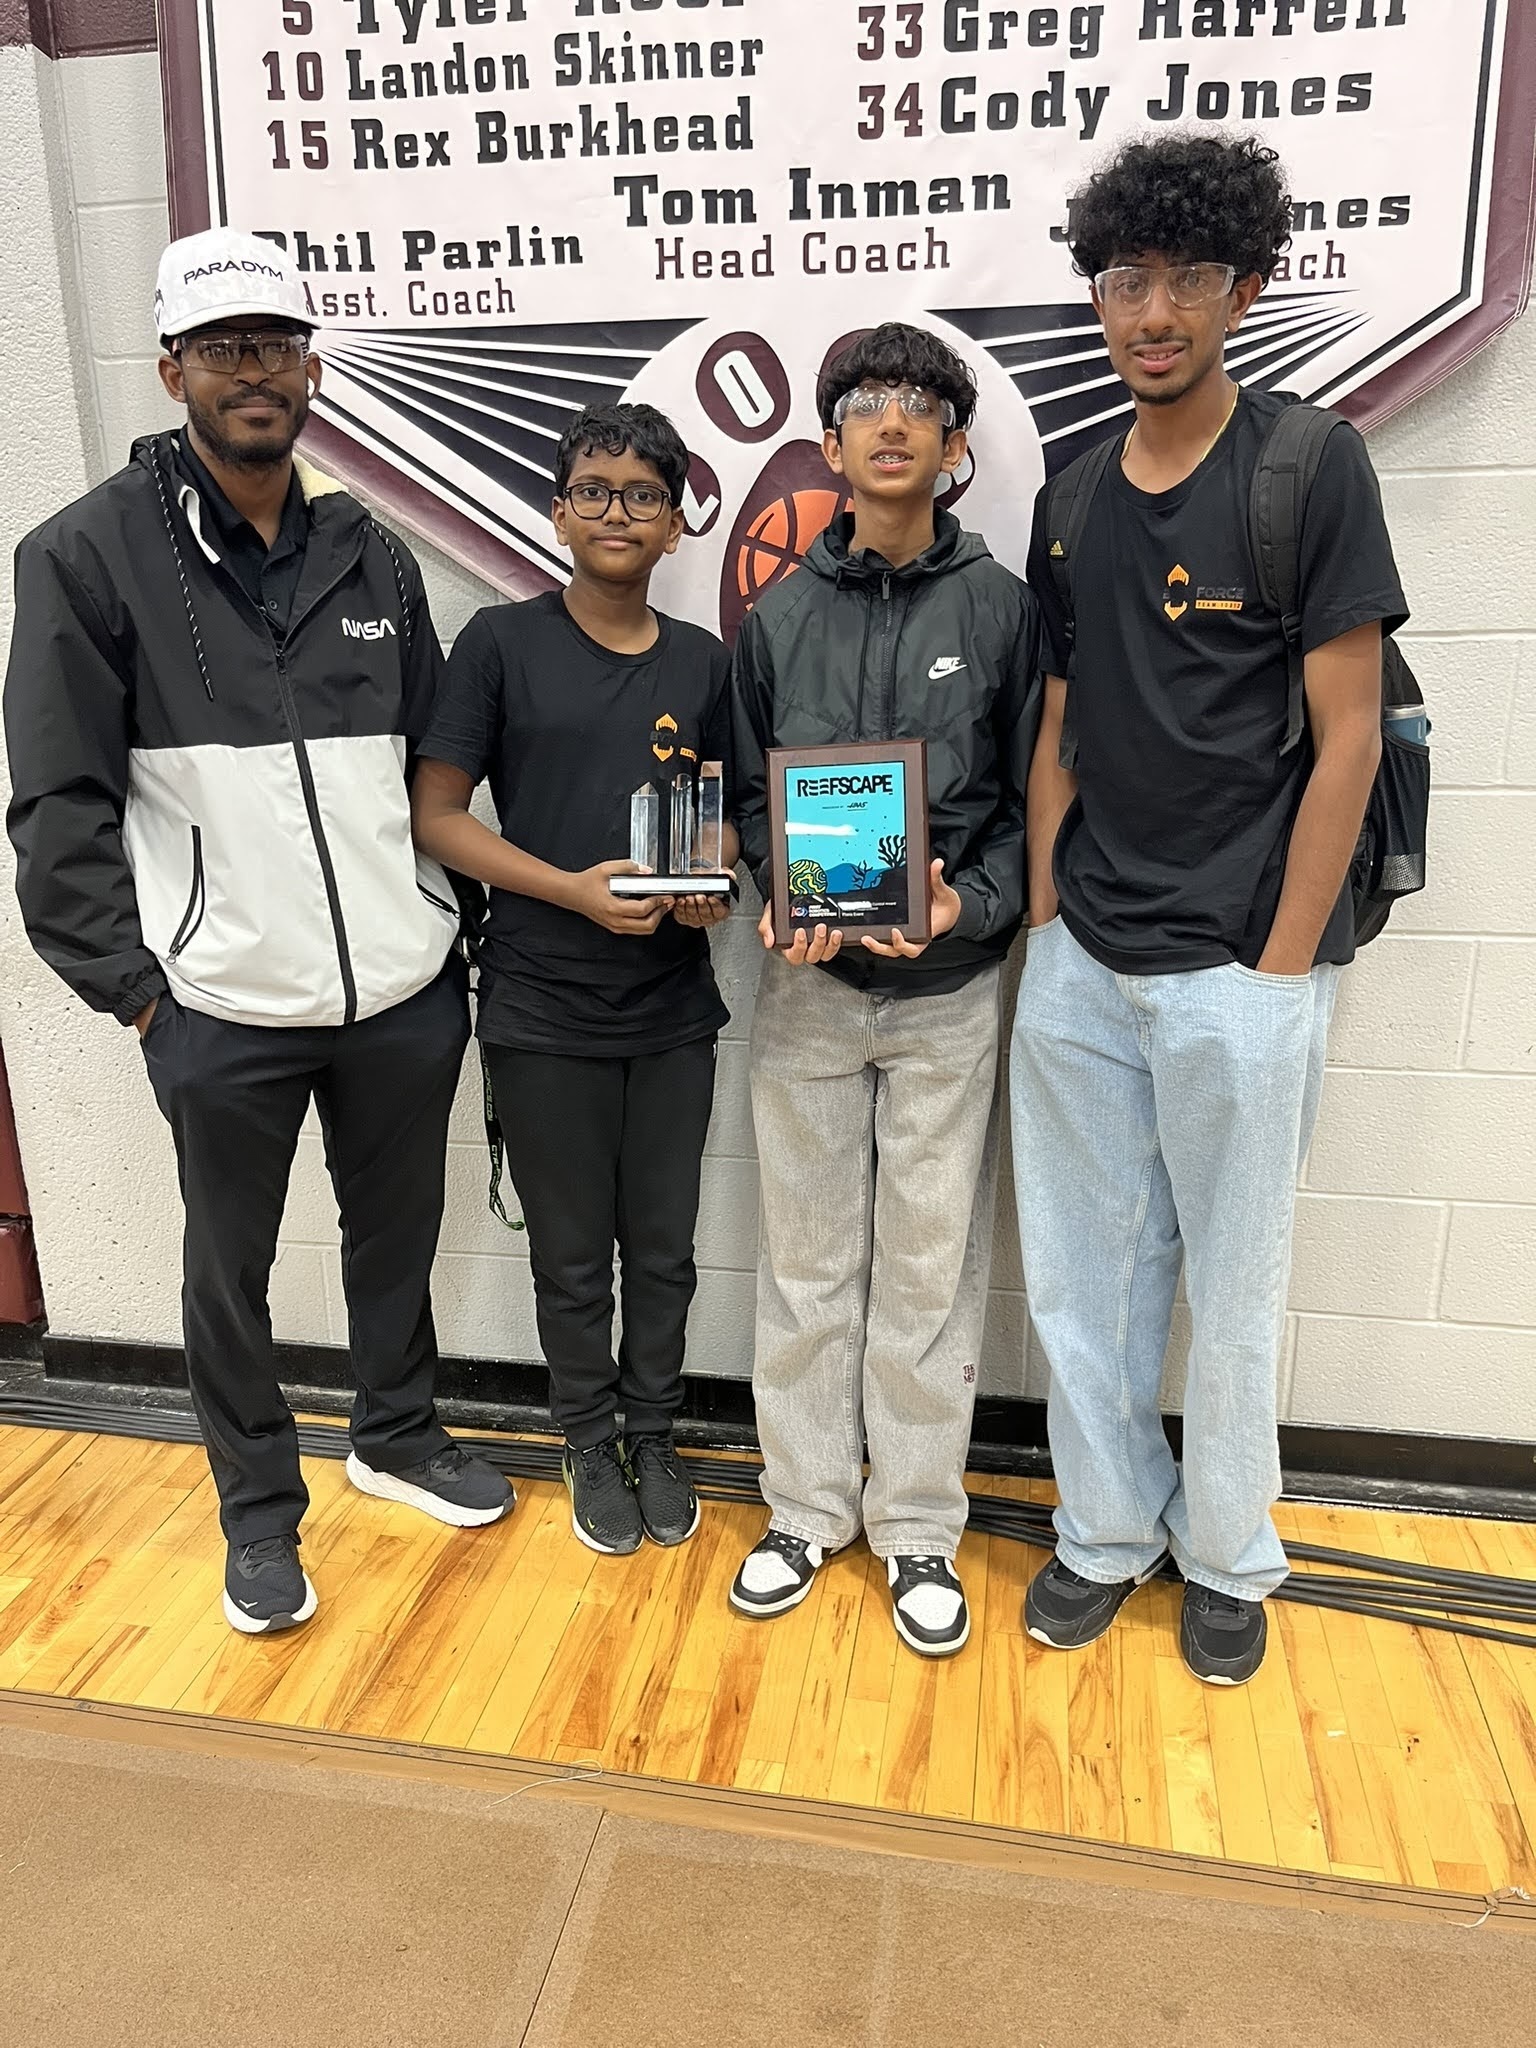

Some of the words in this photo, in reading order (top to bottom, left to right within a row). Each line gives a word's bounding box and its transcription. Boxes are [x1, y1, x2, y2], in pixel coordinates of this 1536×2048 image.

[283, 0, 312, 36] 5
[858, 3, 923, 60] 33
[944, 0, 1104, 59] Greg
[262, 51, 323, 101] 10
[346, 43, 529, 100] Landon
[555, 31, 763, 87] Skinner
[858, 83, 922, 139] 34
[941, 71, 1109, 140] Cody
[1147, 64, 1372, 121] Jones
[267, 120, 329, 169] 15
[351, 118, 451, 170] Rex
[476, 96, 753, 164] Burkhead
[614, 175, 757, 227] Tom
[789, 168, 1011, 220] Inman
[1290, 195, 1411, 232] nes
[403, 226, 583, 271] Parlin
[655, 235, 774, 280] Head
[803, 227, 950, 275] Coach
[1271, 240, 1346, 282] ach
[184, 260, 284, 285] PARADYM
[407, 277, 516, 316] Coach
[1197, 587, 1245, 600] FORCE
[341, 617, 397, 640] NASA
[933, 656, 961, 670] NIKE
[797, 774, 893, 798] REEFSCAPE
